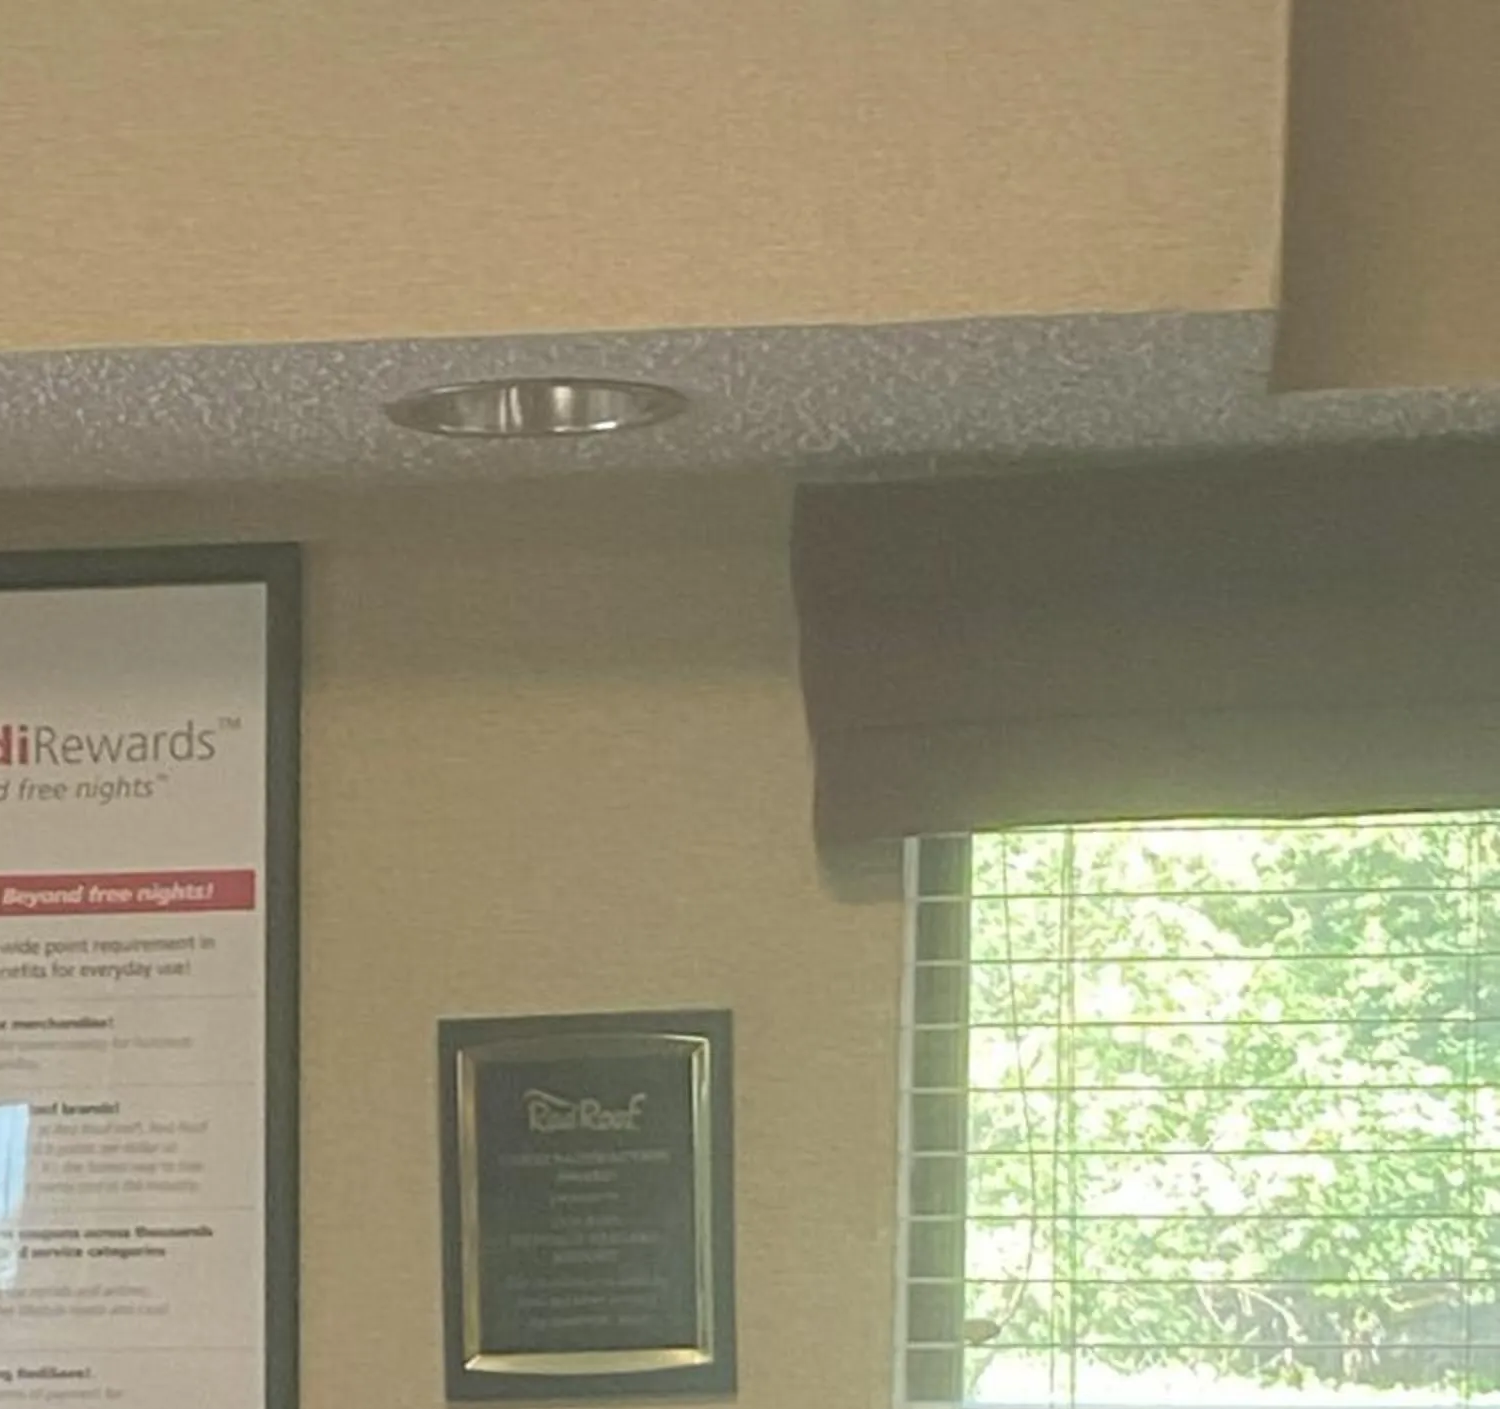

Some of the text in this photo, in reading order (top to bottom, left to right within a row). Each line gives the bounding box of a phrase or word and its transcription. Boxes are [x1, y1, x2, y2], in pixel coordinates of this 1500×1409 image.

[19, 778, 67, 801] free
[3, 885, 84, 908] Beyond
[89, 883, 133, 902] free
[137, 881, 215, 905] nights!
[45, 938, 88, 956] point
[93, 936, 195, 954] requirement
[200, 936, 216, 949] in
[52, 961, 76, 977] for
[80, 960, 151, 980] everyday
